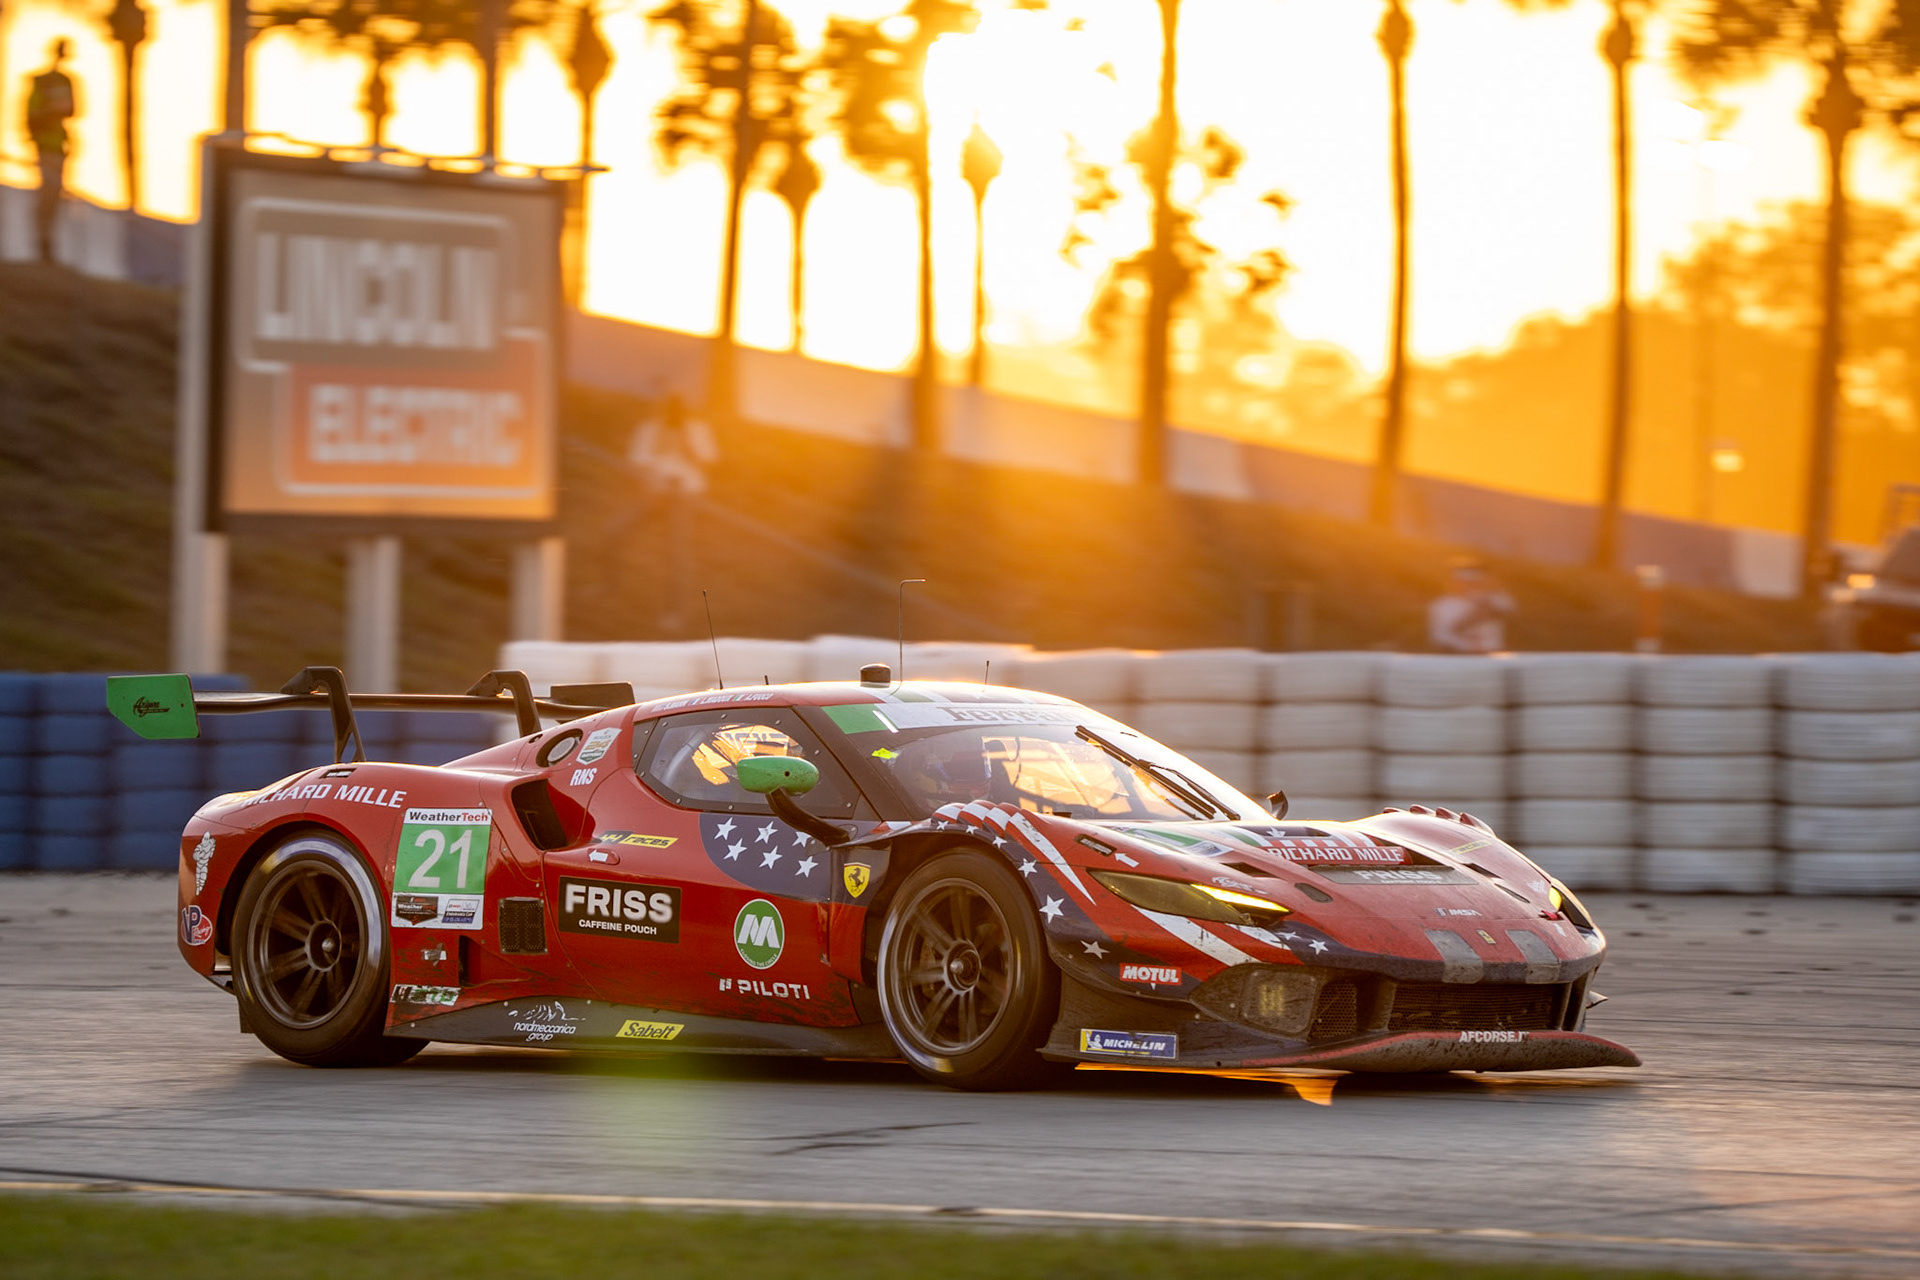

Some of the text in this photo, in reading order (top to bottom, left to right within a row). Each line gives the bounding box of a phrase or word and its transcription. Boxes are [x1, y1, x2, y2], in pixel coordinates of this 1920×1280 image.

[255, 232, 500, 350] LINCOLN
[308, 384, 523, 466] ELECTRIC
[334, 784, 407, 808] MILLE
[409, 811, 488, 822] WeatherTech
[625, 836, 671, 847] races
[408, 829, 473, 888] 21
[1267, 848, 1405, 862] RICHARD MILLE
[1353, 870, 1443, 880] FRISS
[565, 883, 673, 924] FRISS
[578, 918, 657, 935] CAFFEINE POUCH
[1122, 966, 1179, 983] MOTUL
[737, 979, 810, 1000] PILOTI
[514, 1020, 576, 1034] nordmeccanica
[624, 1022, 675, 1038] Sabelt
[526, 1032, 553, 1042] group
